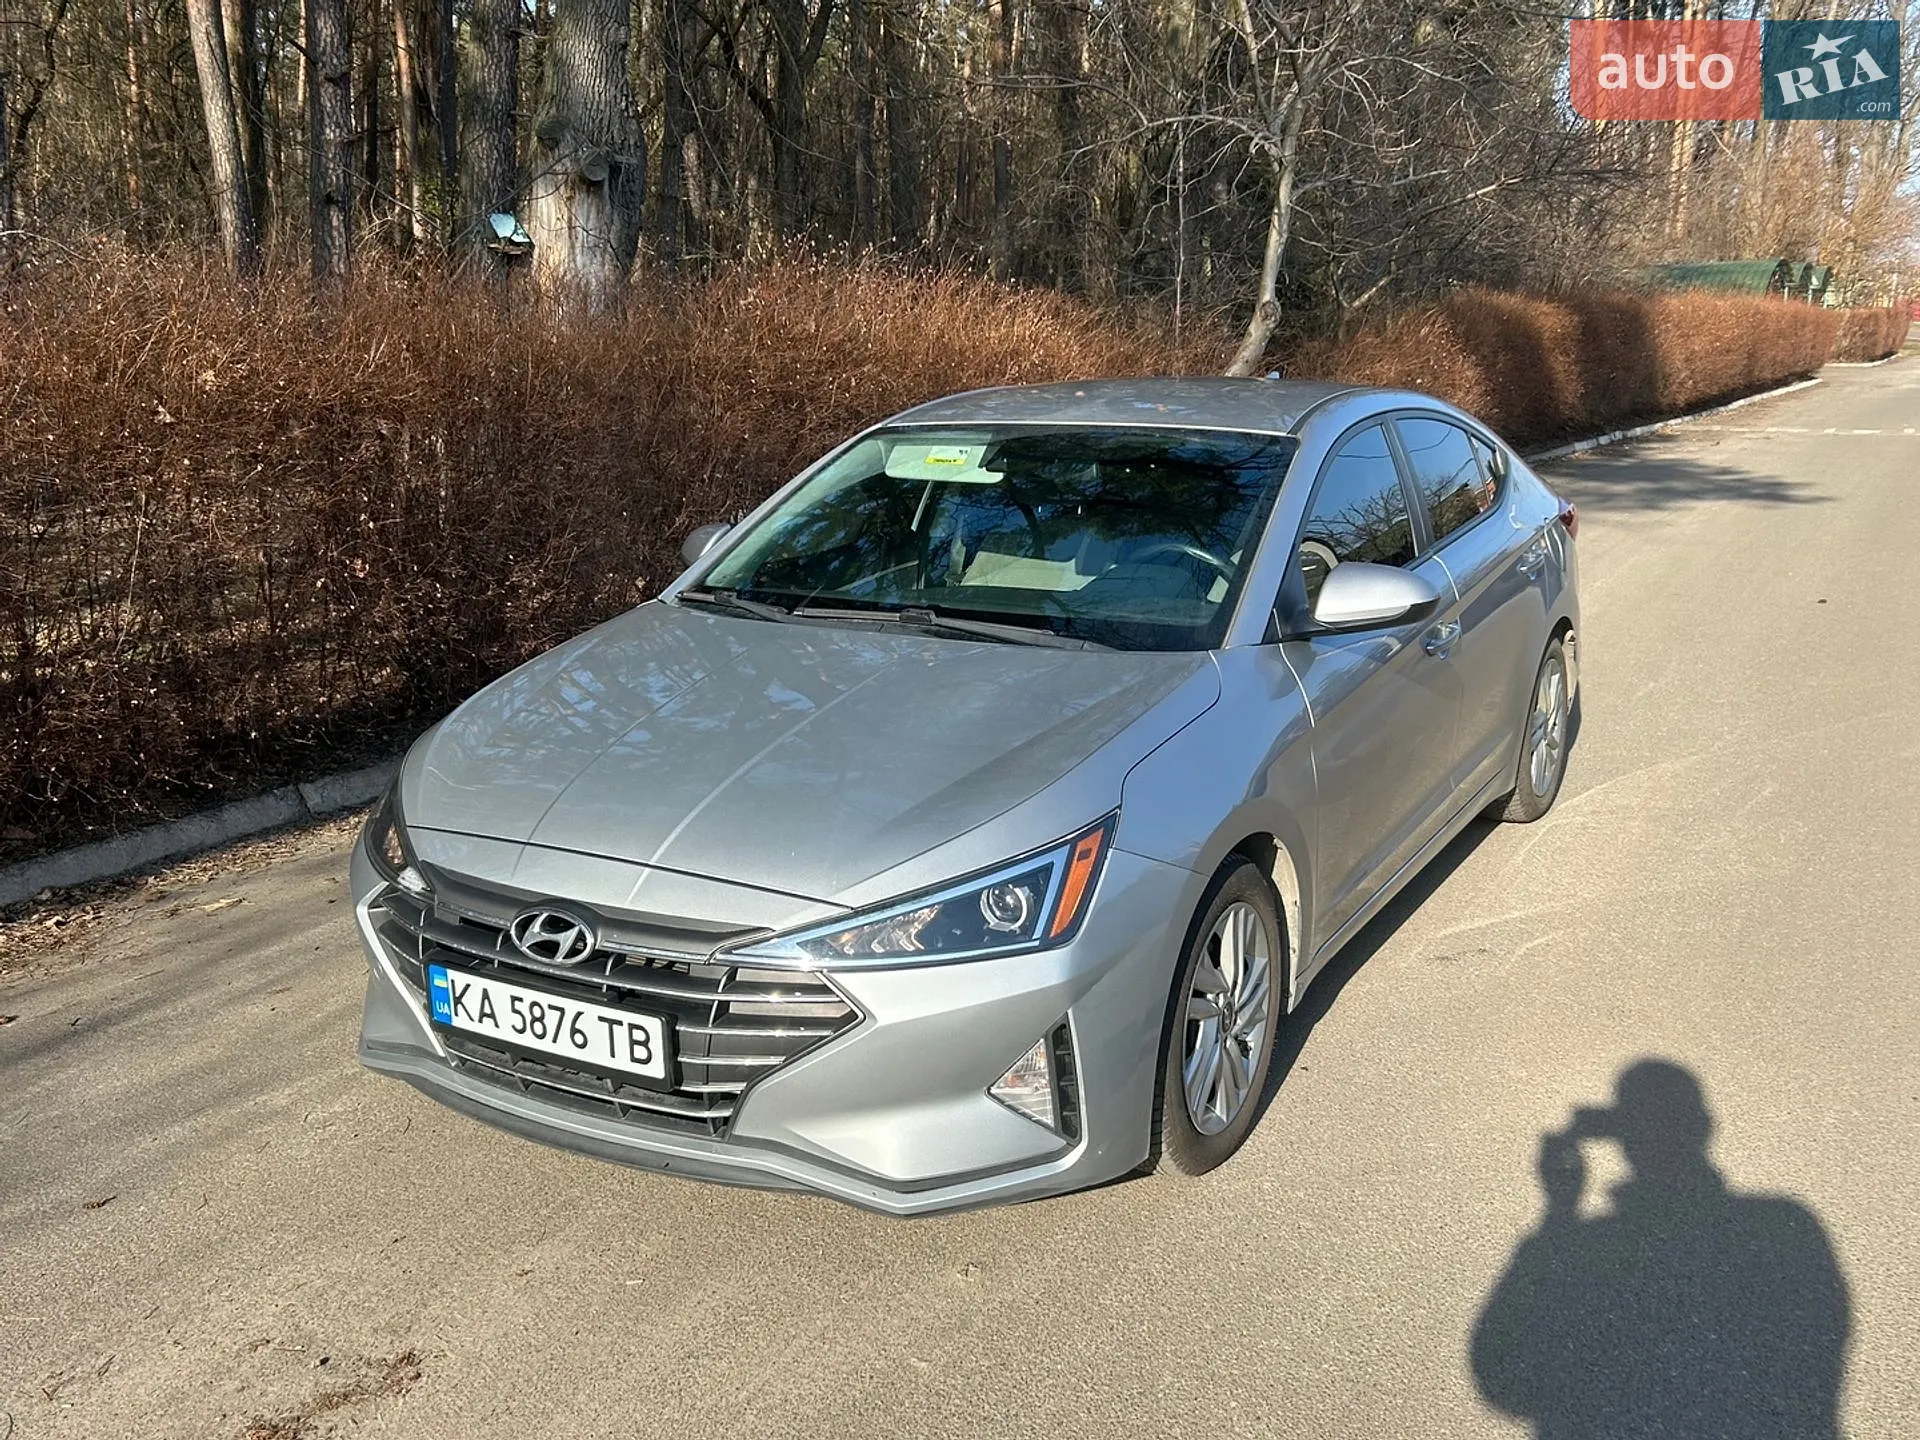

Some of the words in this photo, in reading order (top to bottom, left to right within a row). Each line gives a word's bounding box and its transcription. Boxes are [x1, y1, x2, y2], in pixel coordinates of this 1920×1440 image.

[436, 1000, 450, 1016] UA
[450, 978, 500, 1029] KA
[510, 994, 588, 1050] 5876
[598, 1015, 653, 1066] TB
